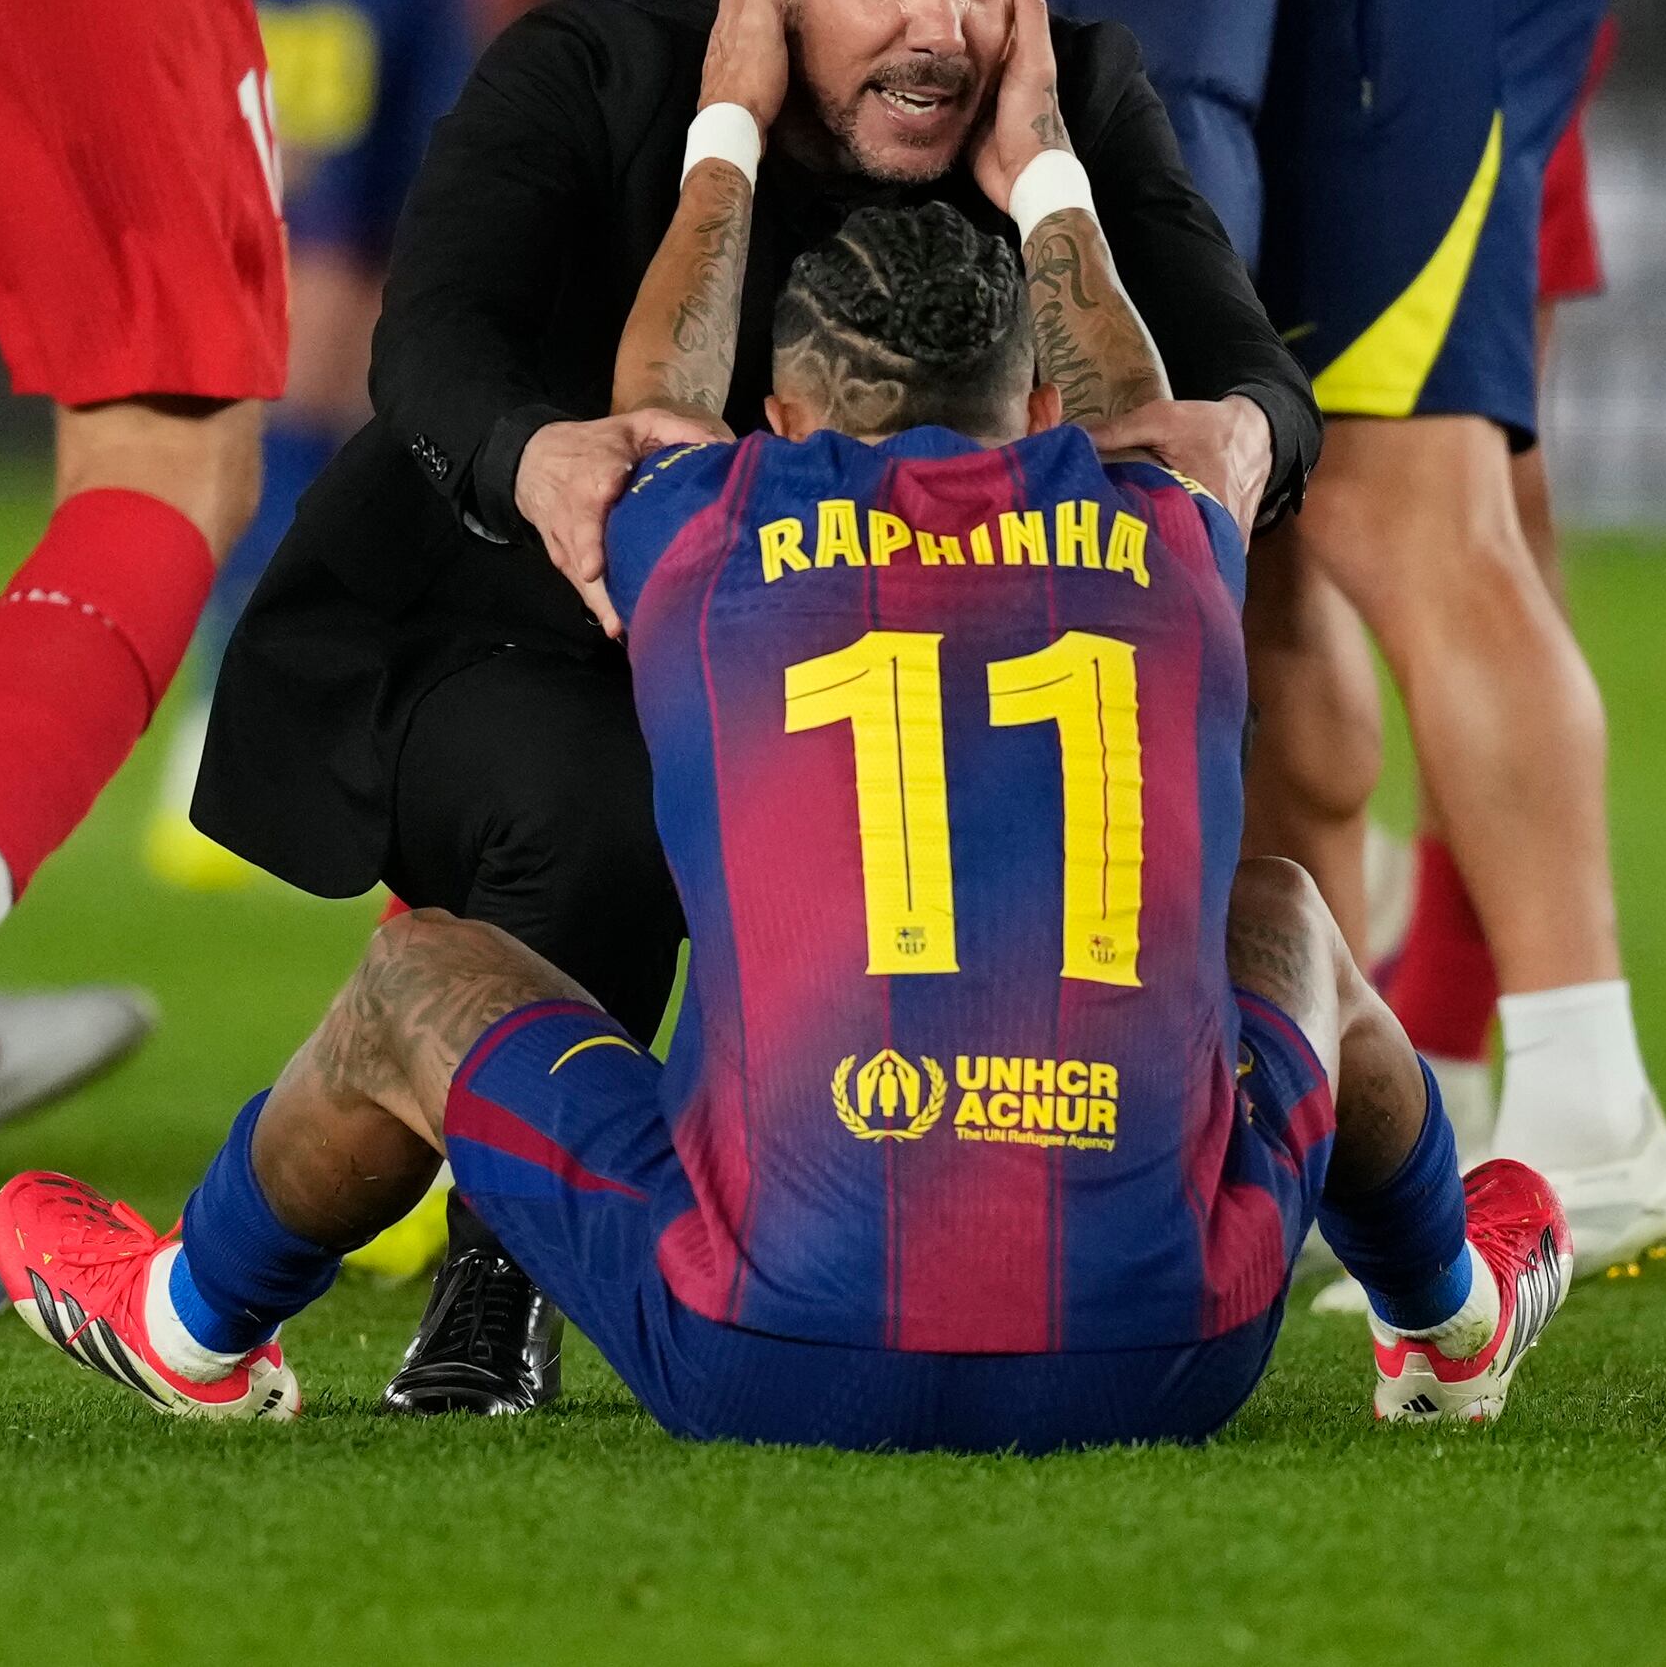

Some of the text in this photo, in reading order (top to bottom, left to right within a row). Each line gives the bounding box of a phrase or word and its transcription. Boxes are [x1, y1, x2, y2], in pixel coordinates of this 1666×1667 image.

[757, 497, 1152, 589] RAPHINHA
[784, 630, 1143, 987] 11
[955, 1055, 1119, 1099] UNHCR
[953, 1092, 1117, 1134] ACNUR
[955, 1127, 1116, 1153] The UN Refugee Agency
